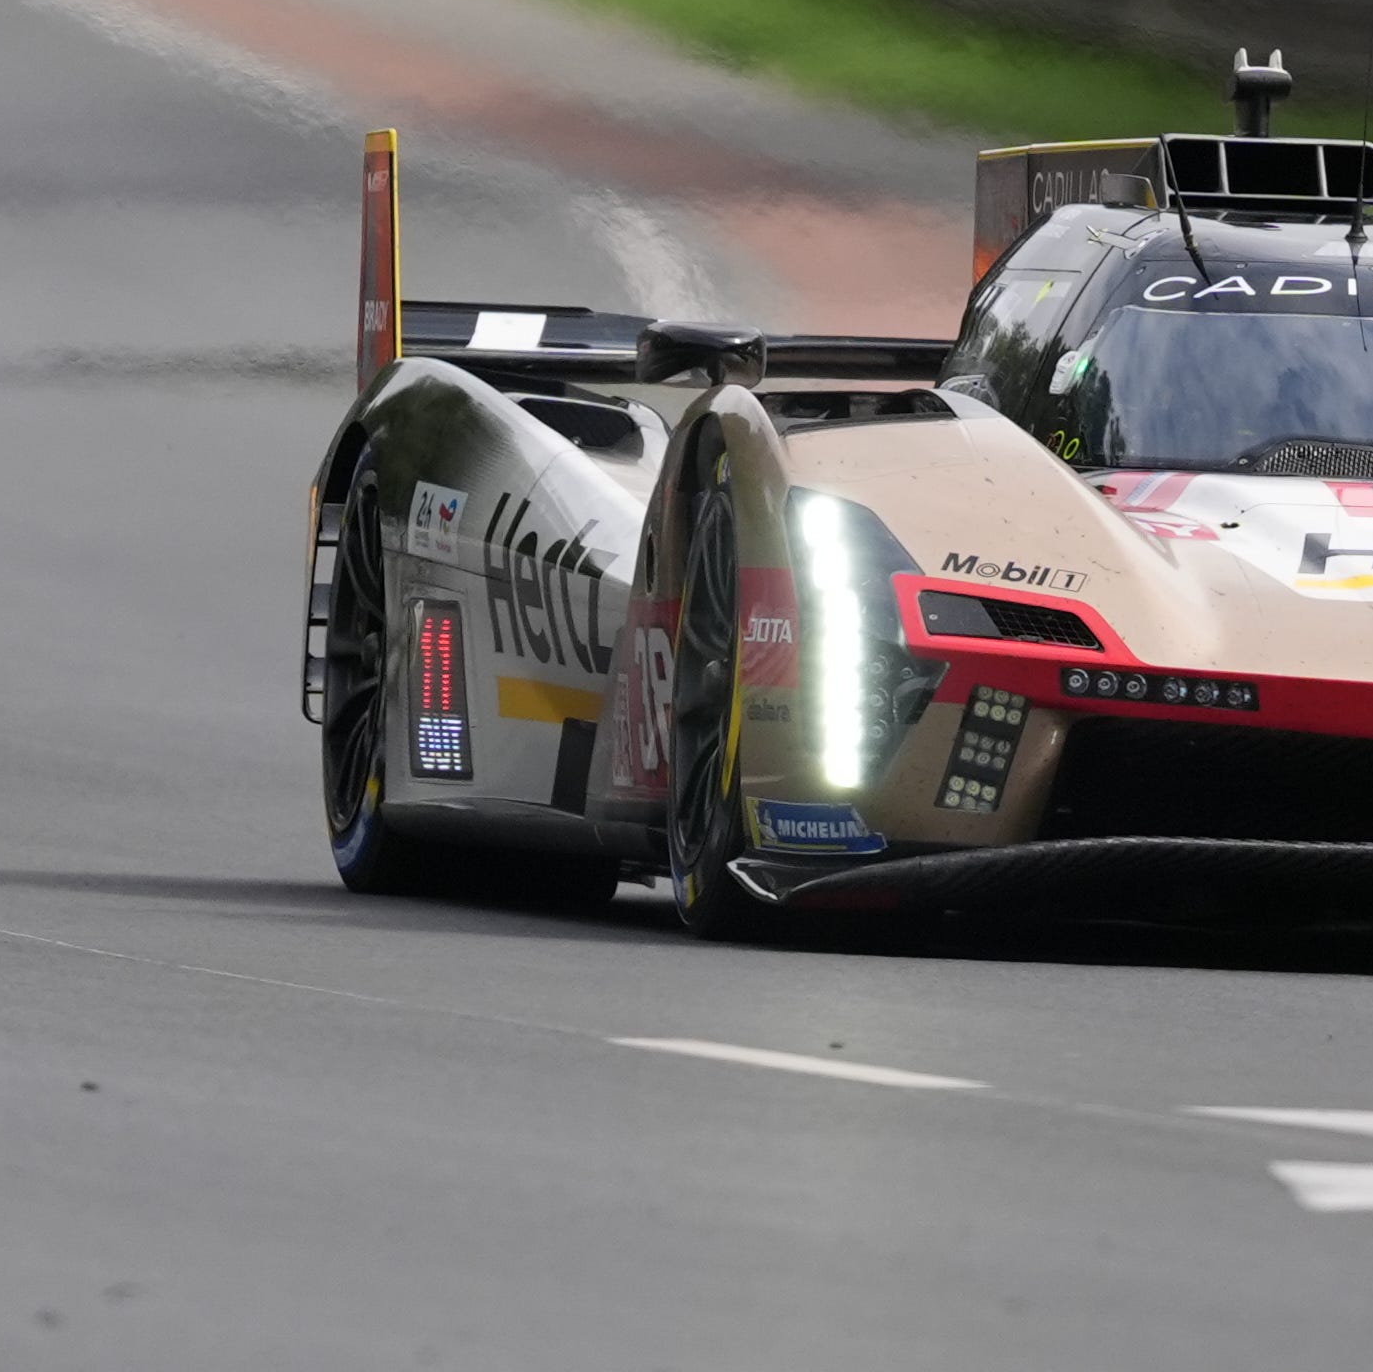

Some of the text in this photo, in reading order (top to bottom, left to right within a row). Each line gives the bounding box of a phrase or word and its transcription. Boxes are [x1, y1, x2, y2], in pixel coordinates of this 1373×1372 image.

[483, 492, 620, 675] Hertz
[940, 552, 1051, 586] Mobil
[743, 617, 793, 644] JOTA
[776, 818, 869, 839] MICHELIN
